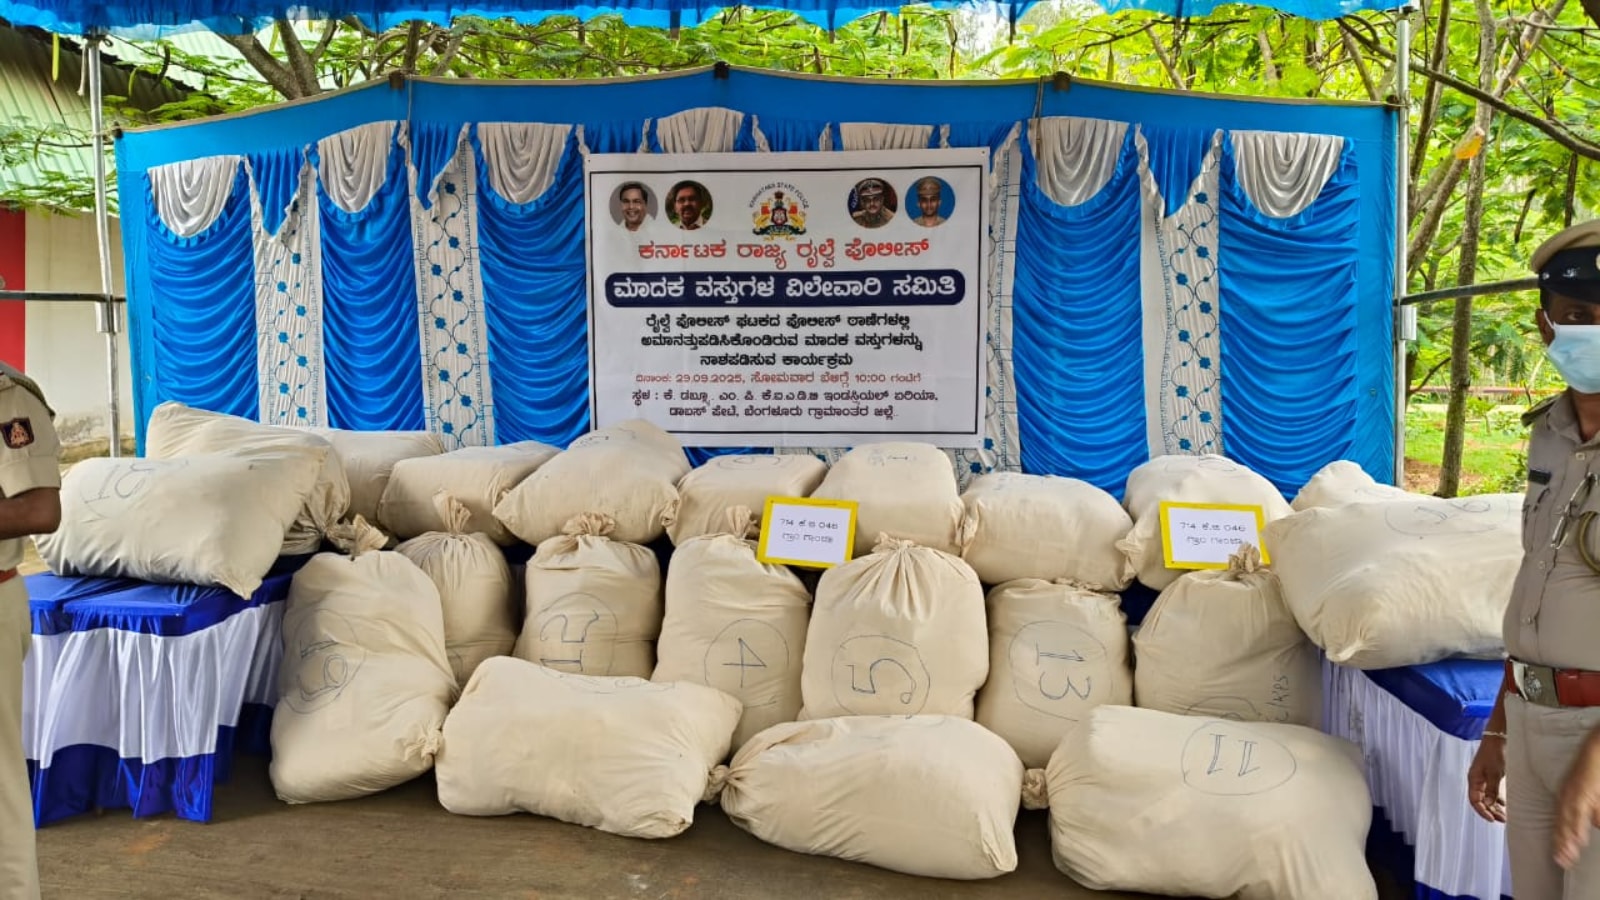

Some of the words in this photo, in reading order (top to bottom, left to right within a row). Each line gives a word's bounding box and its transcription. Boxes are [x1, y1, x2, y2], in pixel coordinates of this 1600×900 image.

[638, 239, 727, 259] ಕರ್ನಾಟಕ
[737, 242, 788, 270] ರಾಜ್ಯ
[613, 276, 685, 298] ಮಾದಕ
[695, 275, 775, 304] ವಸ್ತುಗಳ
[785, 275, 882, 298] ವಿಲೇವಾರಿ
[892, 274, 957, 297] ಸಮಿತಿ
[645, 313, 671, 333] ರೈಲ್ವೆ
[736, 313, 781, 329] ಘಟಕದ
[804, 333, 849, 346] ಮಾದಕ
[854, 331, 923, 351] ವಸ್ತುಗಳನ್ನು
[699, 352, 776, 366] ನಾಶಪಡಿಸುವ
[781, 352, 853, 369] ಕಾರ್ಯಕ್ರಮ
[751, 371, 814, 383] ಸೋಮವಾರ
[855, 373, 886, 383] 10:00
[631, 389, 651, 406] ಸ್ಥಳ
[669, 405, 707, 417] ಡಾಬಸ್
[744, 404, 803, 417] ಬೆಂಗಳೂರು
[721, 636, 768, 690] 4
[1035, 642, 1093, 701] 13
[846, 656, 918, 705] 5
[1206, 733, 1262, 778] 11
